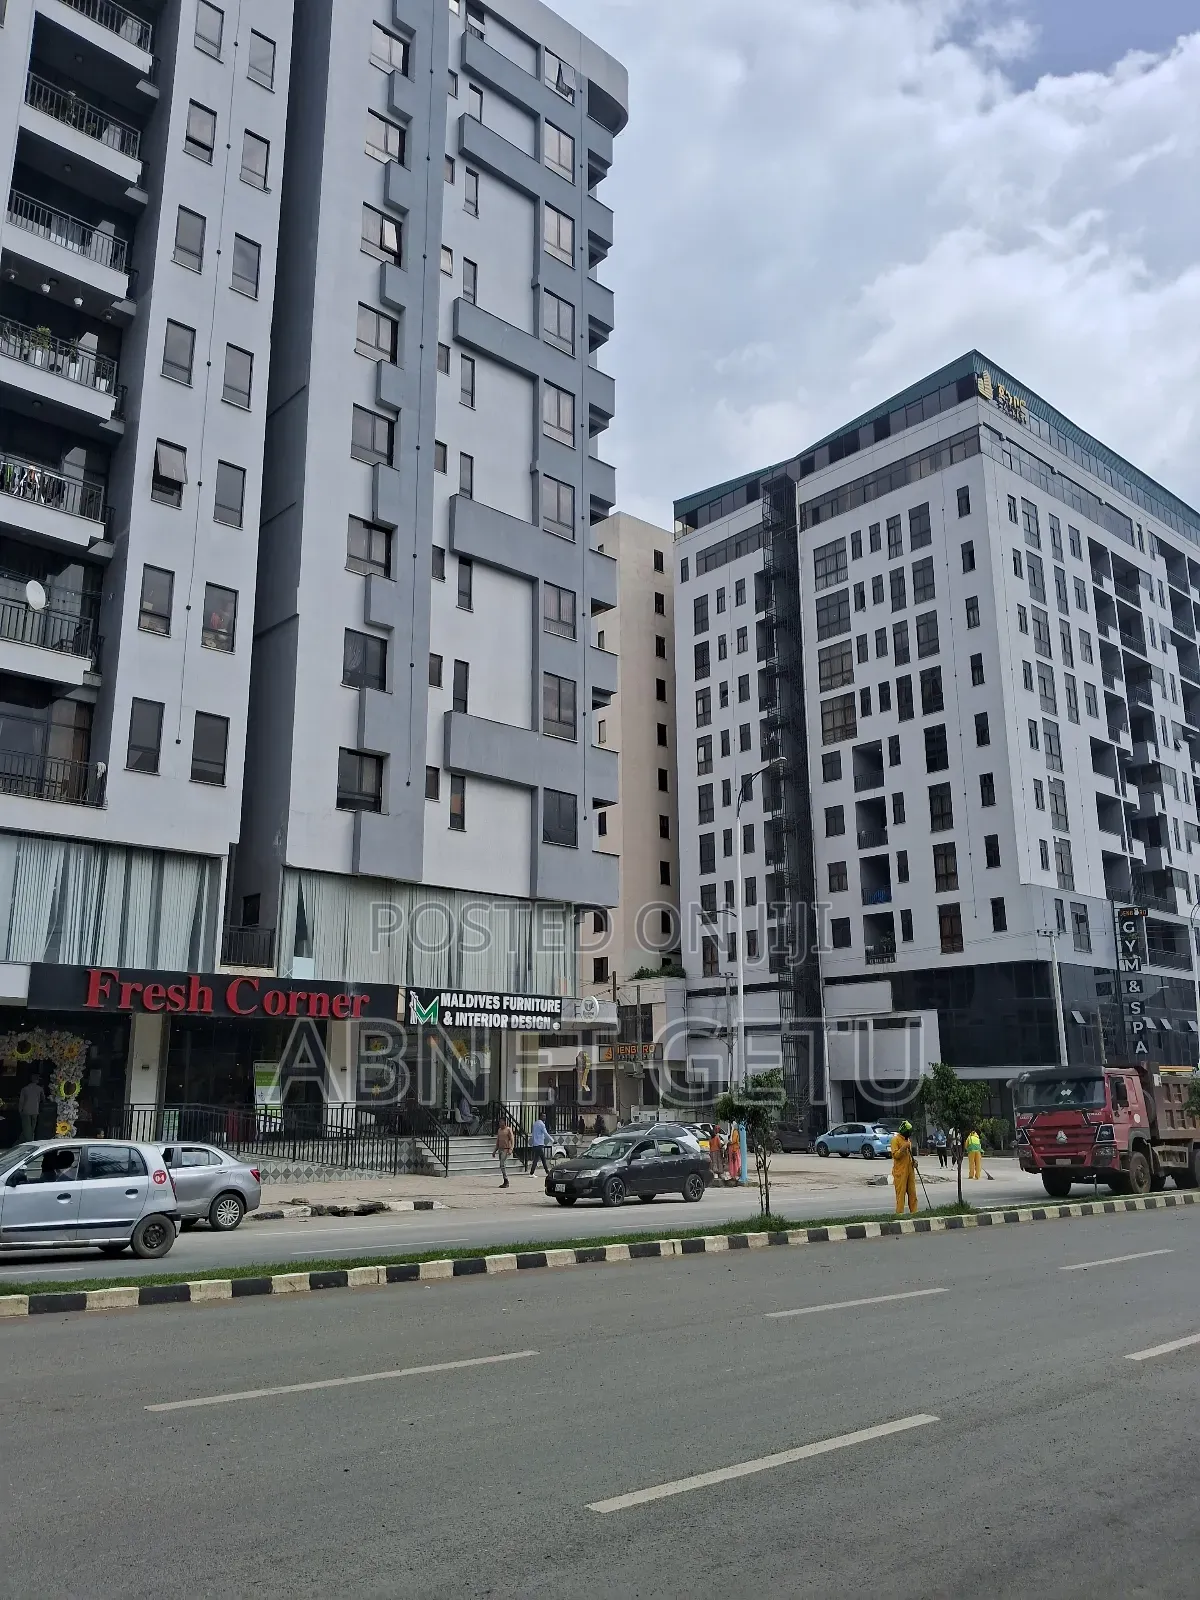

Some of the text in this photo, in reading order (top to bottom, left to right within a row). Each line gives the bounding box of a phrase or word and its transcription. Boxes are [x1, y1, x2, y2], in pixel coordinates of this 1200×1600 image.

[83, 968, 370, 1018] Fresh Corner
[440, 992, 561, 1013] MALDIVES FURNITURE
[1122, 921, 1148, 1054] GYM & SPA
[443, 1010, 551, 1030] & INTERIOR DESIGN
